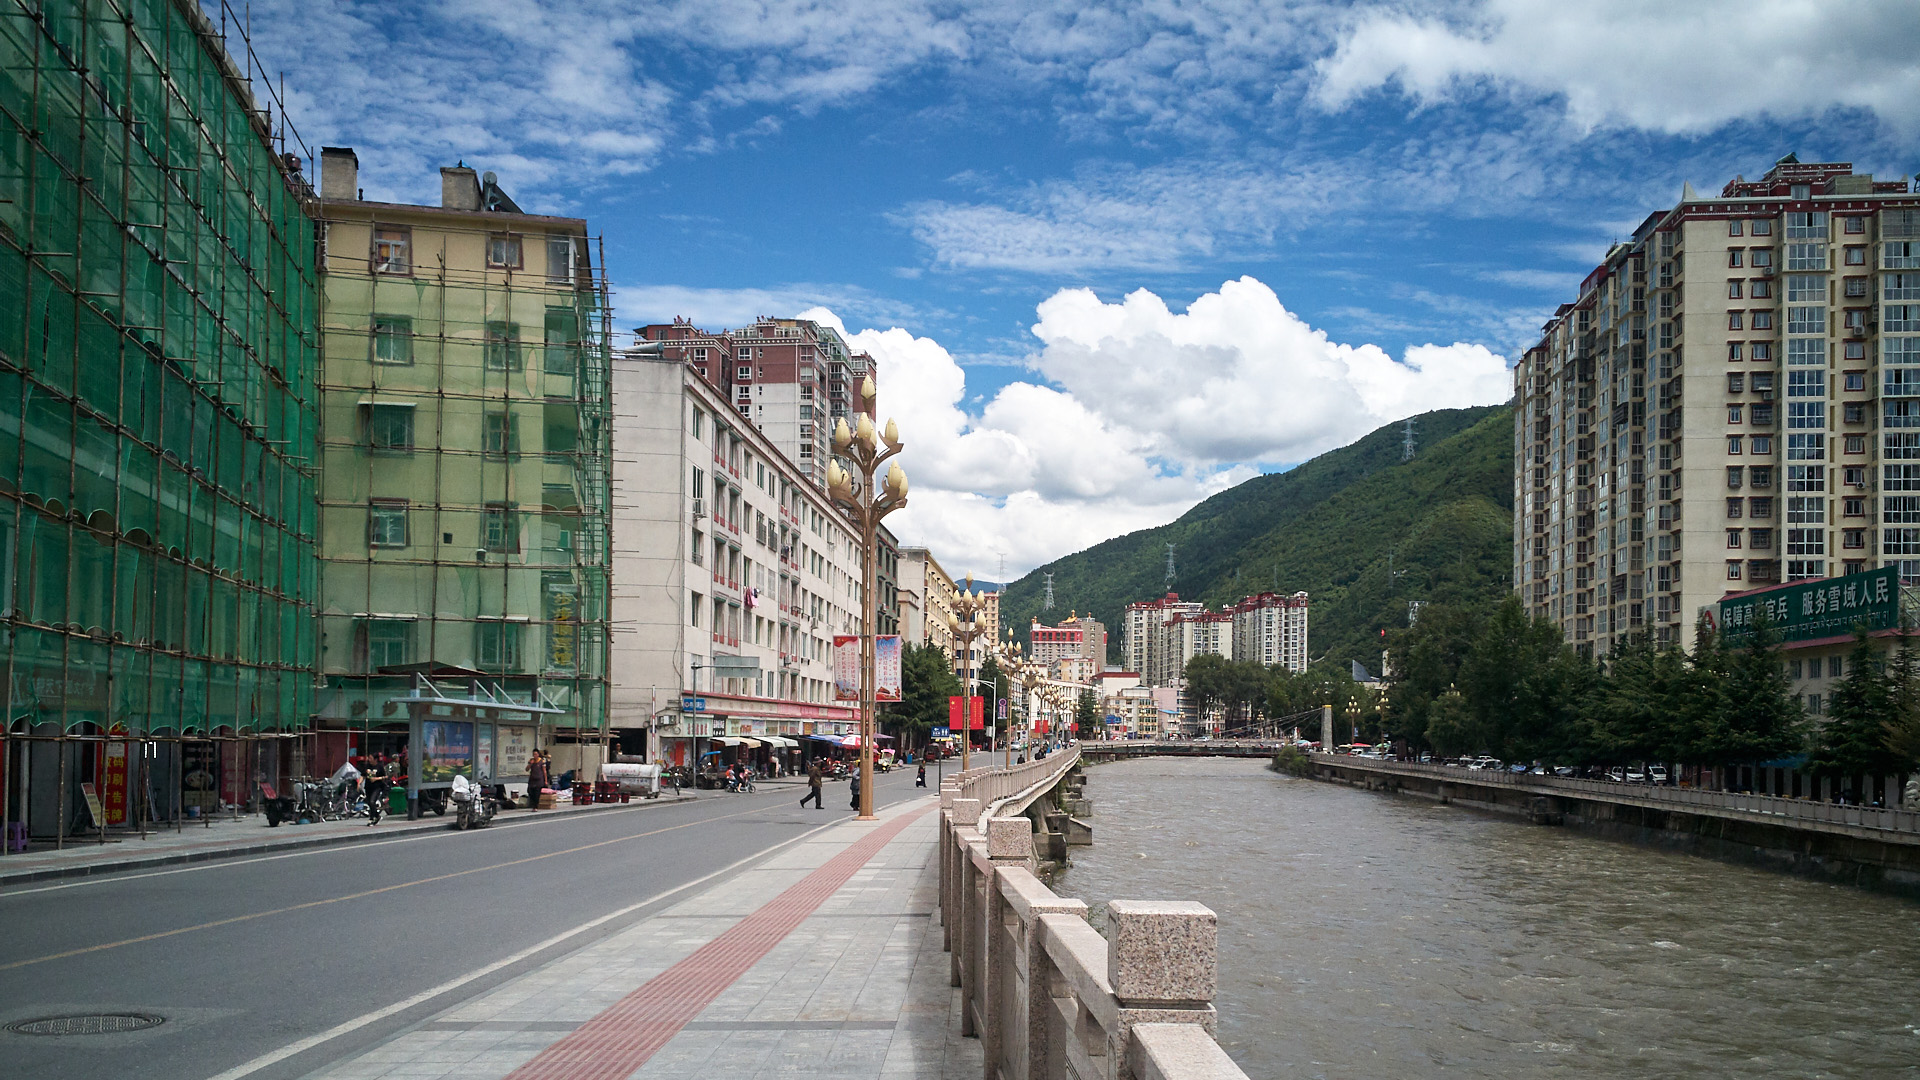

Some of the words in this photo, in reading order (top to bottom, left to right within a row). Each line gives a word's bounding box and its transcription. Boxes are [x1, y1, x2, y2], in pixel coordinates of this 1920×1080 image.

[1722, 596, 1788, 629] 保障高官兵
[1802, 576, 1889, 617] 服务雪域人民
